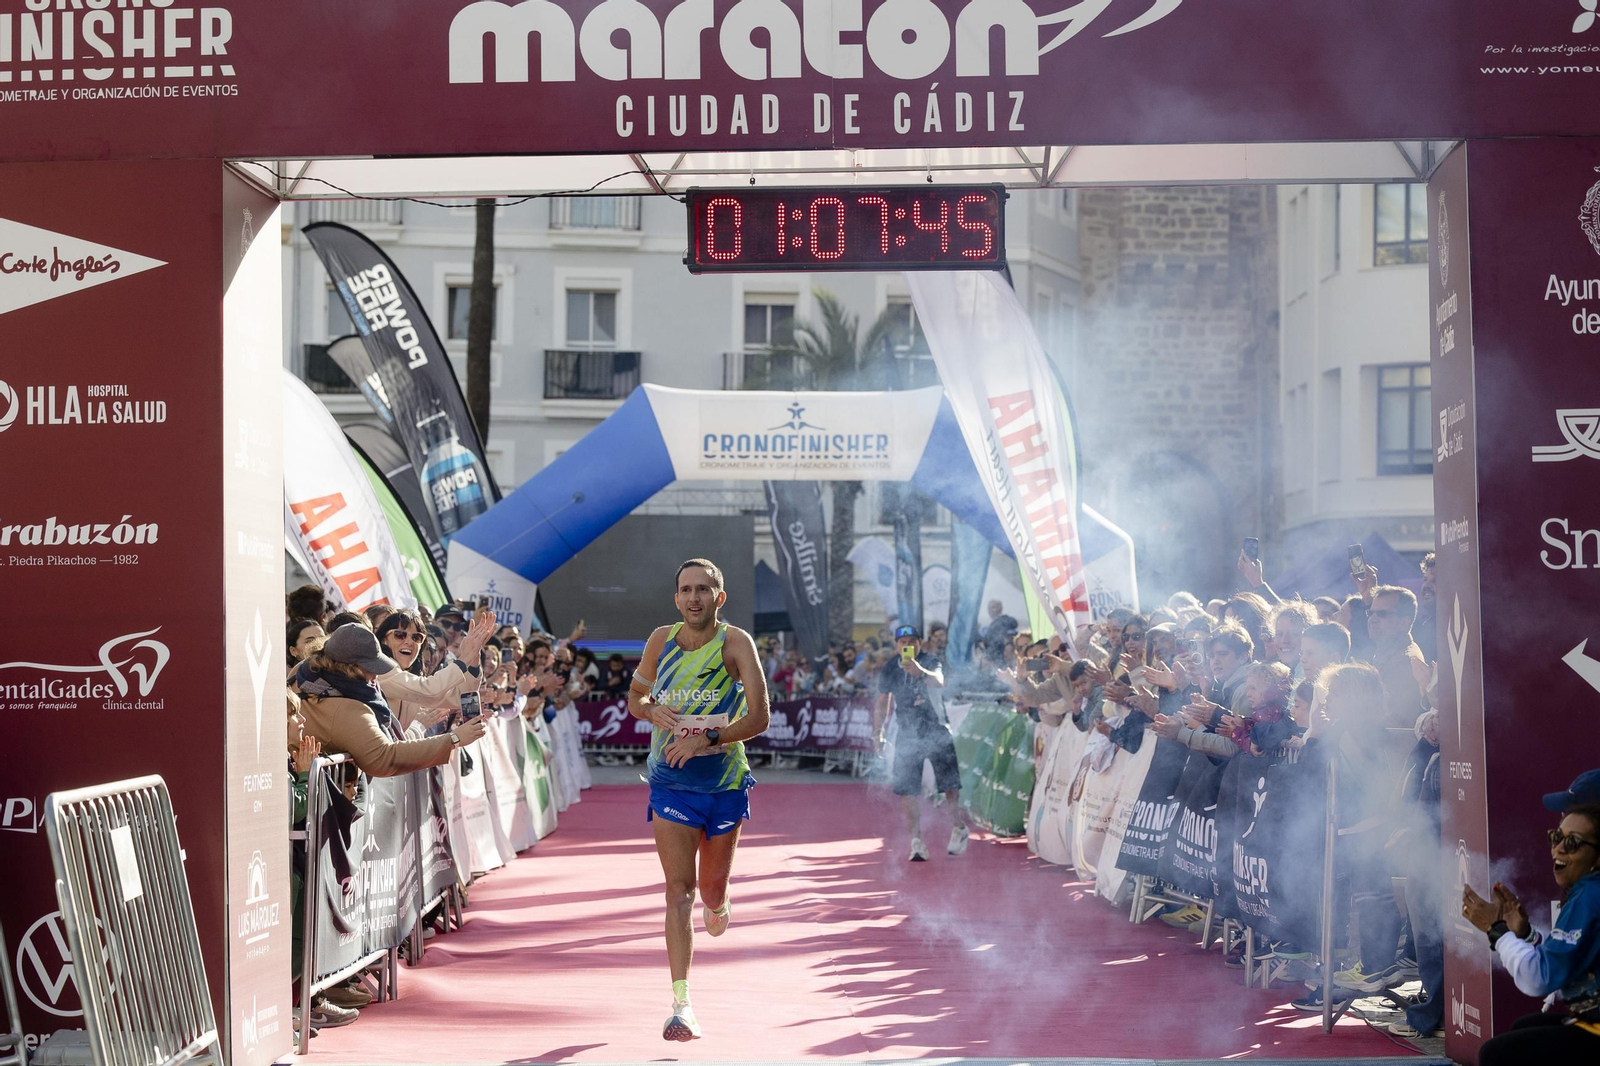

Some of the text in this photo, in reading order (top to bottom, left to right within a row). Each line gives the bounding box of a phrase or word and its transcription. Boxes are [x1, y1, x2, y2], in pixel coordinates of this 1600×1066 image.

[1484, 45, 1505, 53] Por
[1511, 45, 1523, 53] la
[61, 89, 69, 100] Y
[72, 84, 160, 100] ORGANIZACIÓN
[163, 86, 179, 97] DE
[182, 84, 238, 97] EVENTOS
[615, 84, 1026, 138] CIUDAD DE CÁDIZ
[0, 253, 48, 273] Corte
[1572, 308, 1600, 334] de
[88, 384, 129, 397] HOSPITAL
[26, 386, 82, 424] HLA
[88, 400, 167, 424] LA SALUD
[703, 434, 889, 459] CRONOFINISHER
[1540, 518, 1600, 570] Sn
[9, 555, 44, 566] Piedra
[47, 555, 97, 565] Pikachos
[672, 689, 721, 701] HYGGE
[38, 701, 78, 711] franquicia
[102, 699, 164, 710] clínica dental
